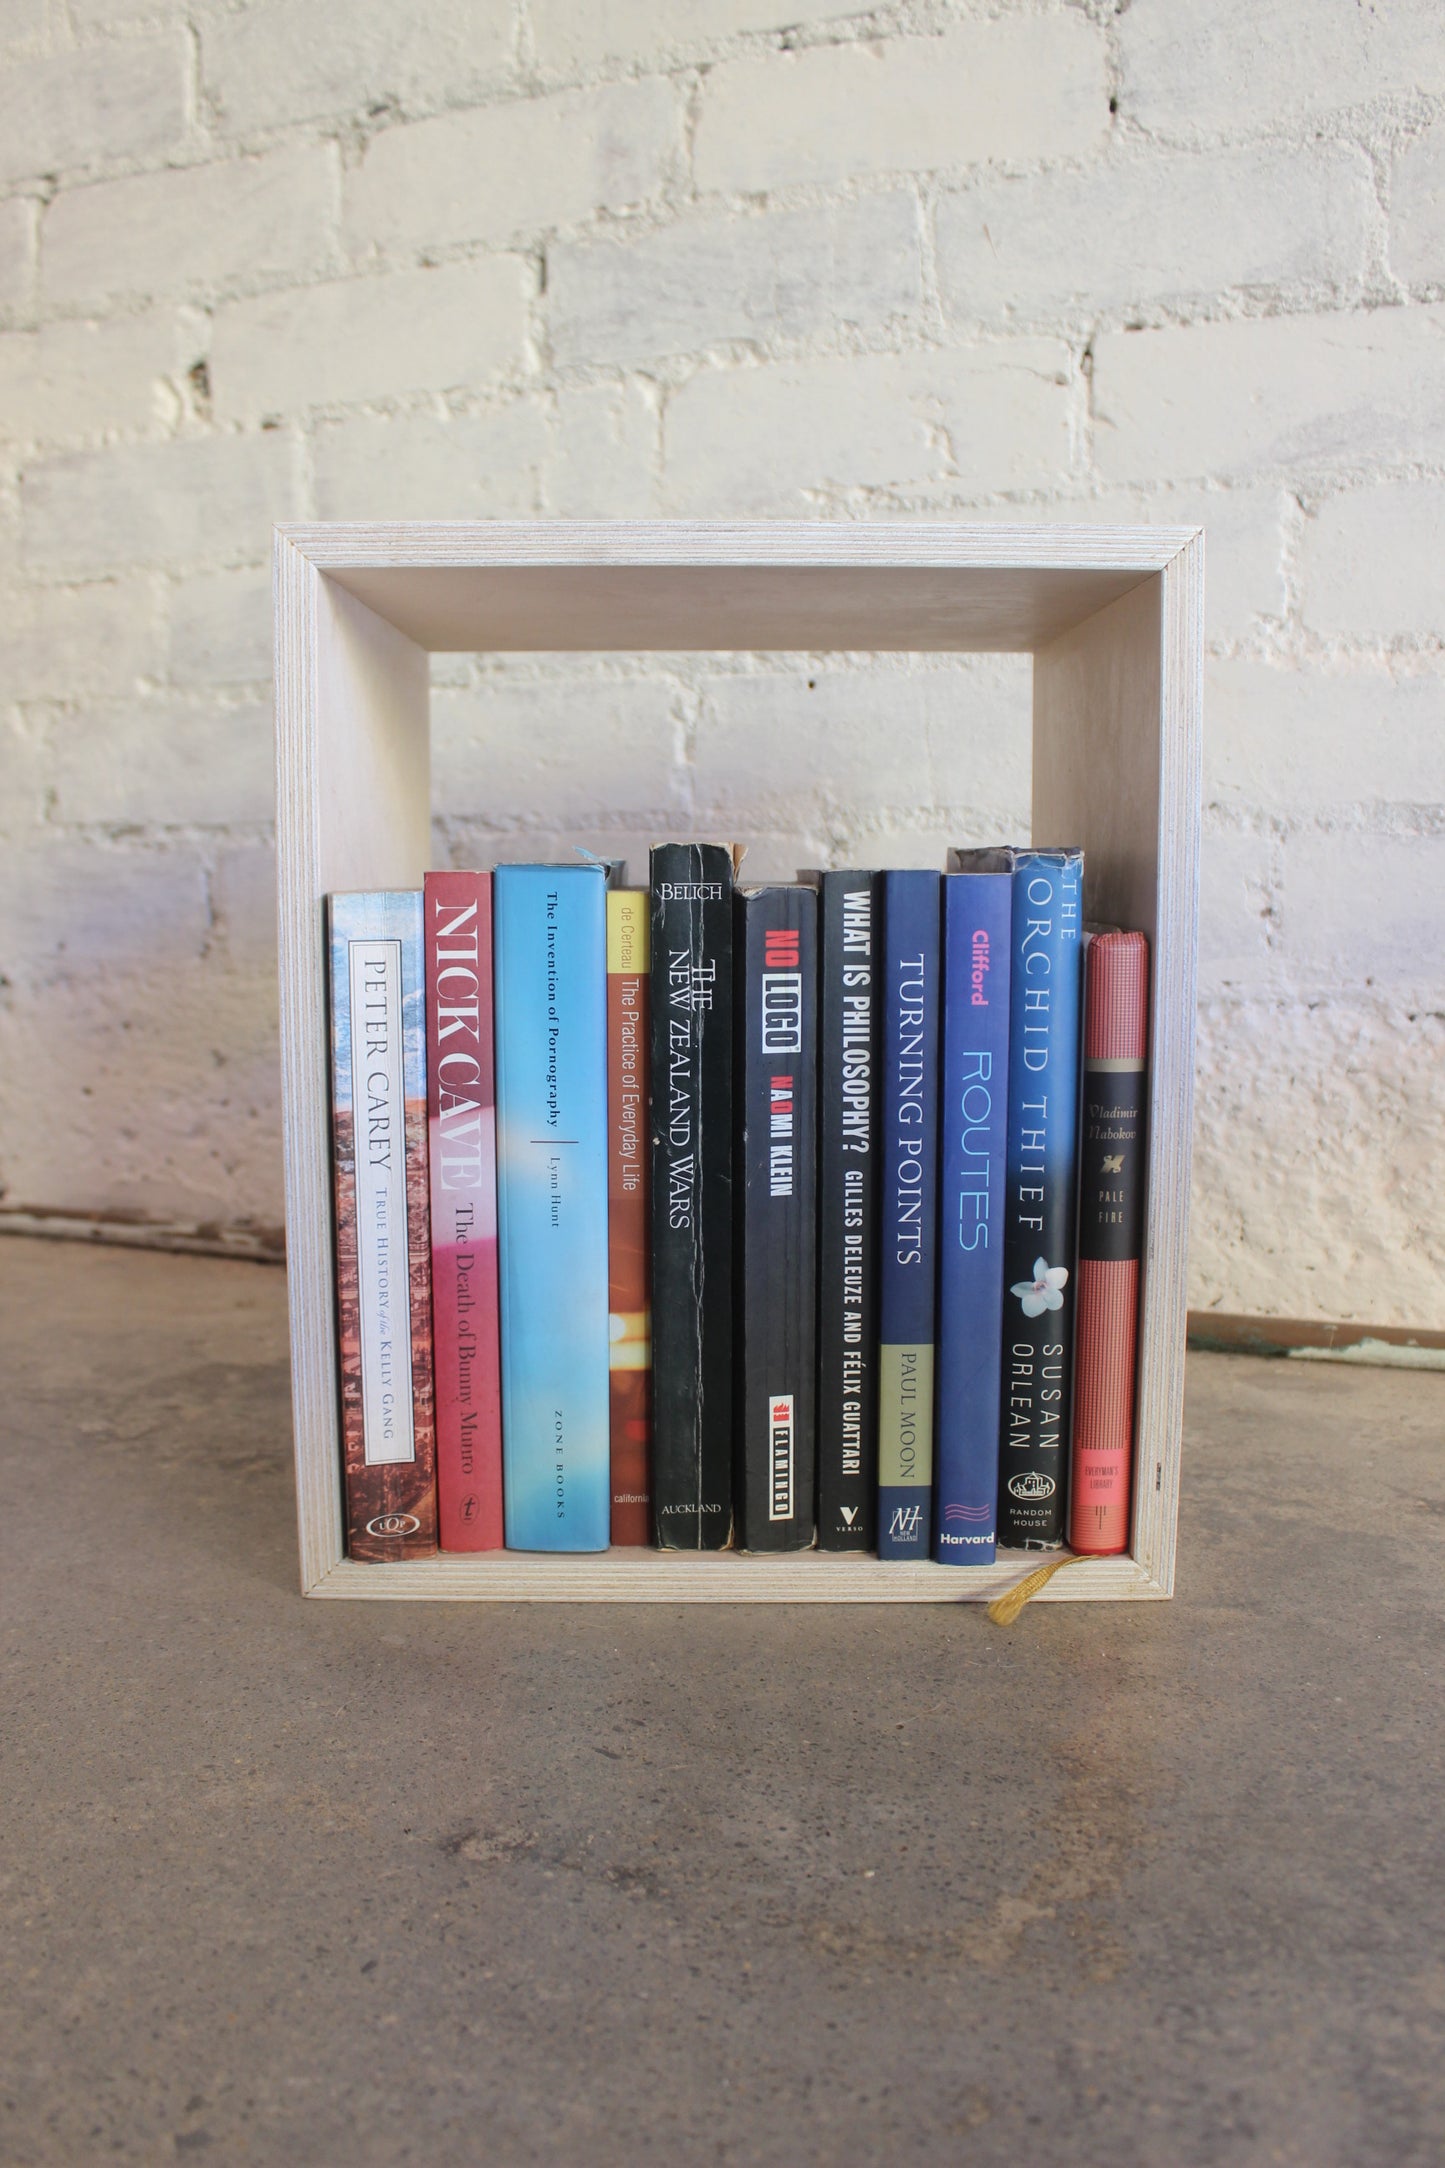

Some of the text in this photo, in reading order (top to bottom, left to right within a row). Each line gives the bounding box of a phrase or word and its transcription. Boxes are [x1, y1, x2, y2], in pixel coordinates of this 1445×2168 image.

[660, 882, 723, 901] BELICH
[1061, 879, 1078, 941] THE
[621, 907, 635, 969] de Certeau
[971, 930, 990, 1006] Clifford
[546, 891, 561, 1128] The Invention of Pornography
[690, 958, 716, 1012] THE
[765, 930, 799, 1047] NO LOGO
[842, 890, 871, 1154] WHAT IS PHILOSOPHY?
[364, 961, 392, 1172] PETER CAREY
[436, 898, 483, 1190] NICK CAVE
[1018, 878, 1053, 1232] ORCHID THIEF
[618, 978, 641, 1191] The Practice of Everyday Life
[669, 949, 693, 1230] NEW ZEALAND WARS
[896, 953, 924, 1265] TURNING POINTS
[1089, 1104, 1138, 1119] Vladimir
[770, 1076, 794, 1197] NAOMI KLEIN
[958, 1051, 992, 1251] ROUTES
[1088, 1126, 1137, 1140] Nabokov
[376, 1187, 388, 1230] TRUE
[547, 1157, 562, 1228] Lynn Hunt
[1098, 1190, 1125, 1202] PALE
[1098, 1211, 1124, 1223] FIRE
[377, 1238, 389, 1309] HISTORY
[455, 1202, 478, 1475] The Death of Bunny Munro
[842, 1170, 866, 1475] GILLES DELEUZE AND FÉLIX GUATTARI
[380, 1341, 393, 1387] KELLY
[1009, 1343, 1034, 1449] ORLEAN
[1039, 1343, 1064, 1449] SUSAN
[382, 1393, 394, 1440] GANG
[900, 1352, 917, 1479] PAUL MOON
[554, 1409, 566, 1519] ZONE BOOKS
[775, 1430, 789, 1512] FLAMINGO
[661, 1504, 722, 1515] AUCKLAND
[940, 1532, 995, 1545] Harvard
[1009, 1508, 1052, 1516] RANDOM
[1013, 1519, 1048, 1527] HOUSE
